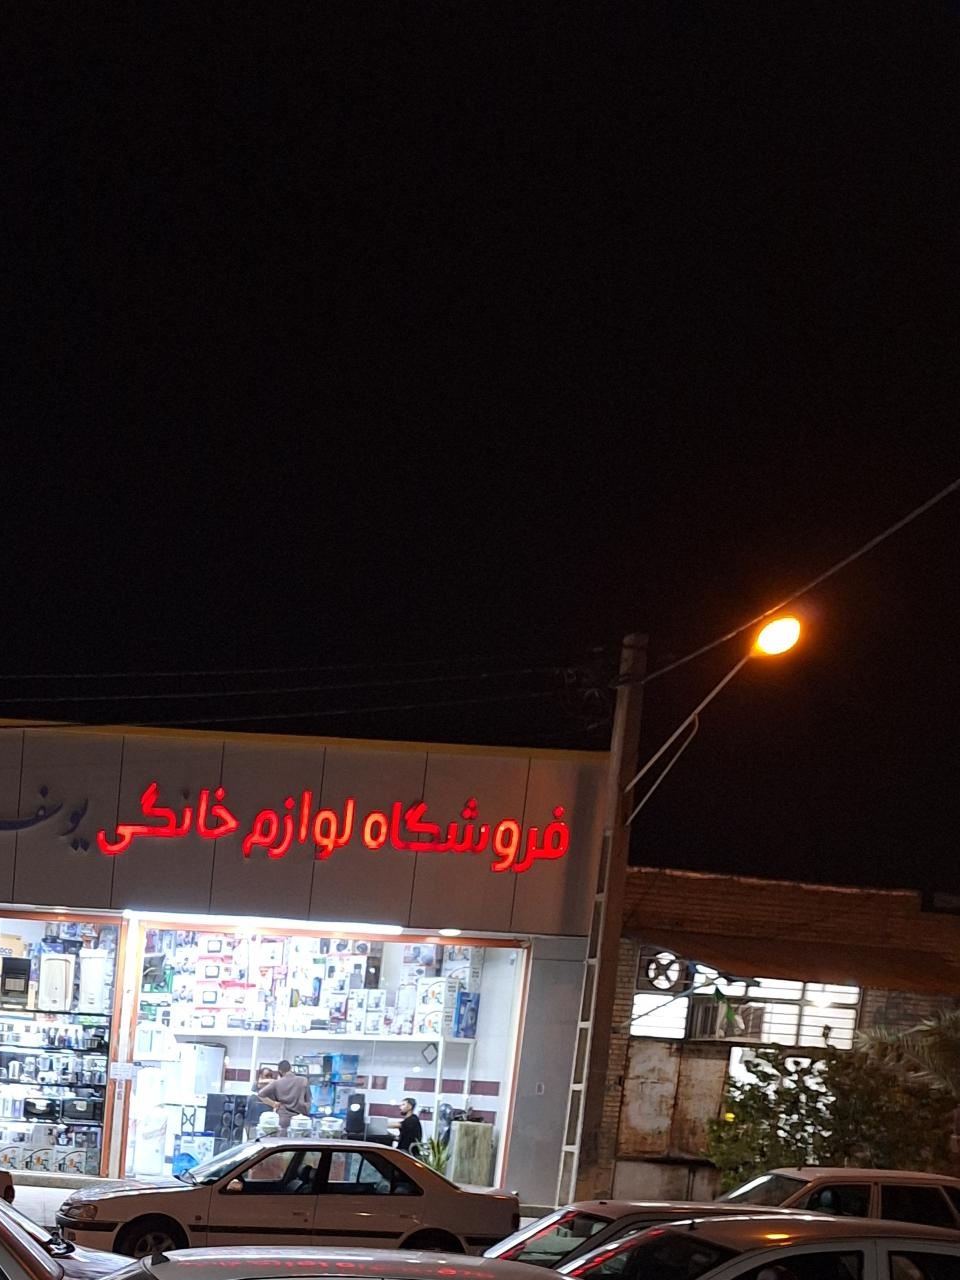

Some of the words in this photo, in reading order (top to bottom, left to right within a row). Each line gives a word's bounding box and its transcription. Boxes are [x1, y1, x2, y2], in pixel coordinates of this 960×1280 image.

[96, 781, 239, 856] خانگی
[242, 788, 357, 861] لوازم
[362, 798, 571, 873] فروشگاه
